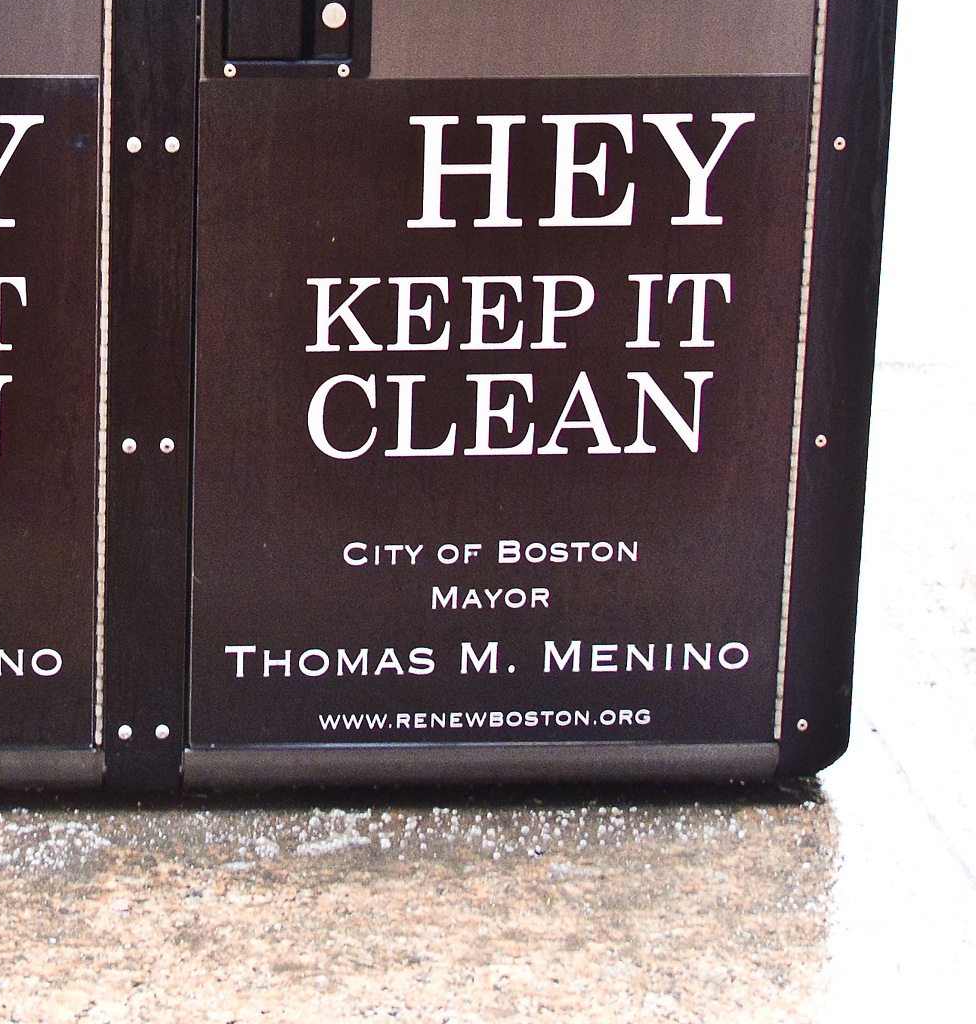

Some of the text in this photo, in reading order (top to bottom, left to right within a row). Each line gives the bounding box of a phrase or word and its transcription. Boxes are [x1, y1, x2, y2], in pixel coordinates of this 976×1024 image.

[406, 112, 756, 229] HEY
[305, 273, 731, 353] KEEP IT
[307, 370, 714, 460] CLEAN
[343, 539, 638, 566] CITY OF BOSTON
[431, 585, 550, 610] MAYOR
[224, 640, 749, 678] THOMAS M. MENINO
[318, 708, 651, 730] WWW.RENEWBOSTON.ORG
